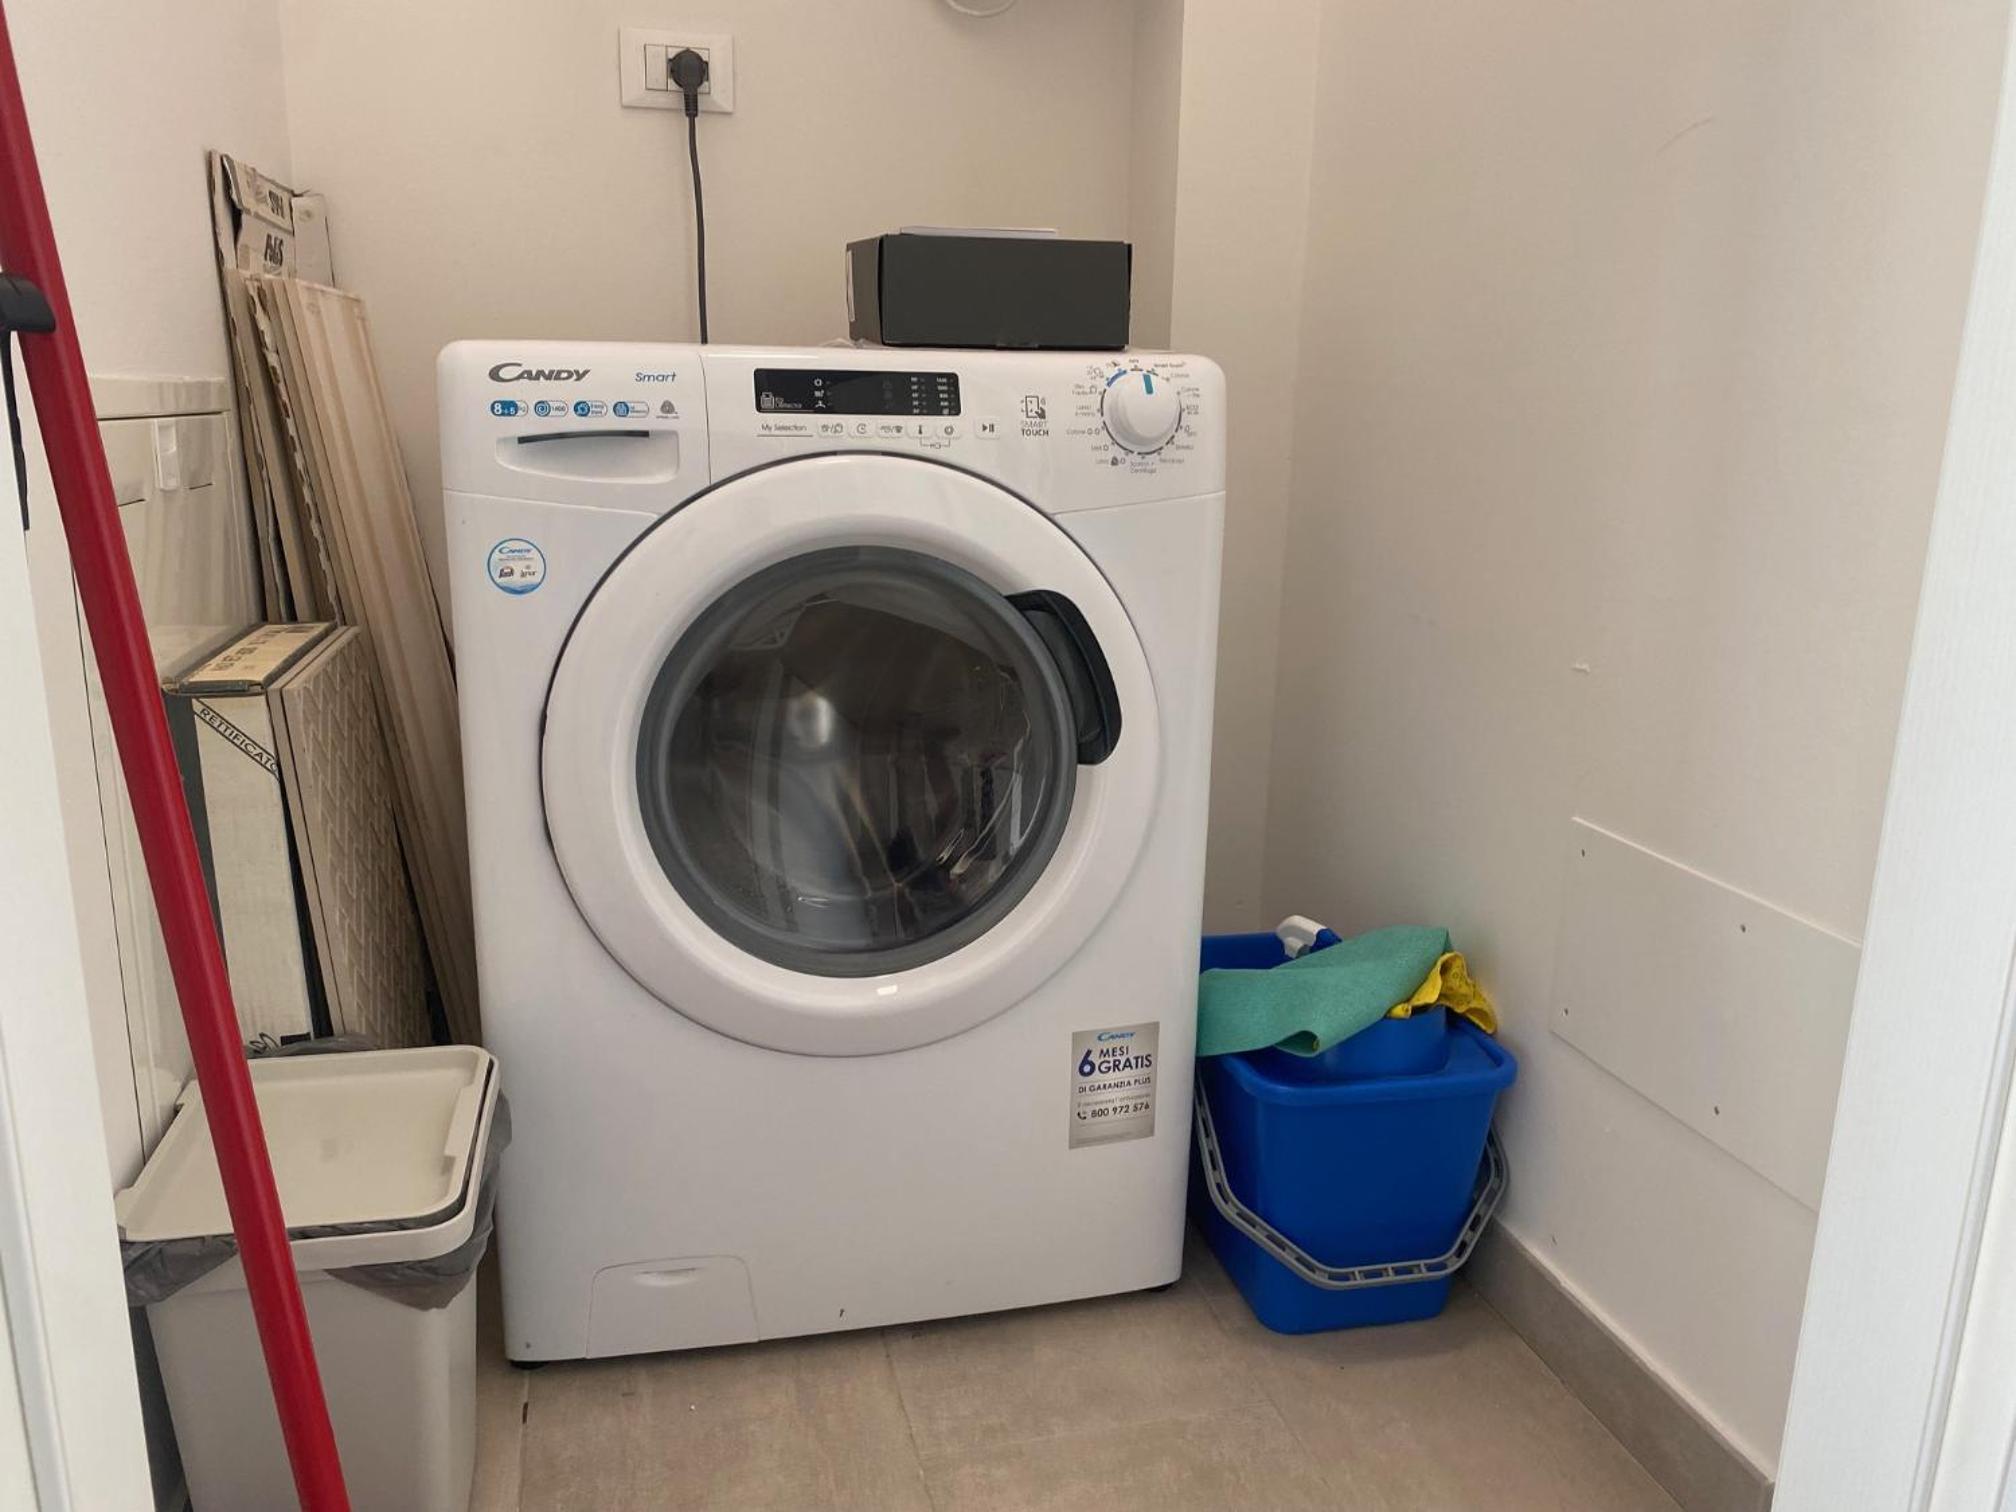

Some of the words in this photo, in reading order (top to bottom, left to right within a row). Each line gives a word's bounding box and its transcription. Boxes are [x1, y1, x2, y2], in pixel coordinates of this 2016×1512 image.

[488, 362, 591, 383] CANDY
[635, 371, 677, 383] Smart
[761, 423, 772, 432] My
[1021, 420, 1047, 428] SMART
[1021, 429, 1049, 437] TOUCH
[199, 706, 280, 774] RETTIFICATO
[1097, 1031, 1136, 1042] CANDY
[1099, 1045, 1129, 1059] MESI
[1078, 1048, 1096, 1078] 6
[1098, 1054, 1152, 1075] GRATIS
[1078, 1086, 1087, 1094] DI
[1089, 1080, 1132, 1093] GARANZIA
[1134, 1076, 1152, 1086] PLUS
[1112, 1104, 1130, 1116] 972
